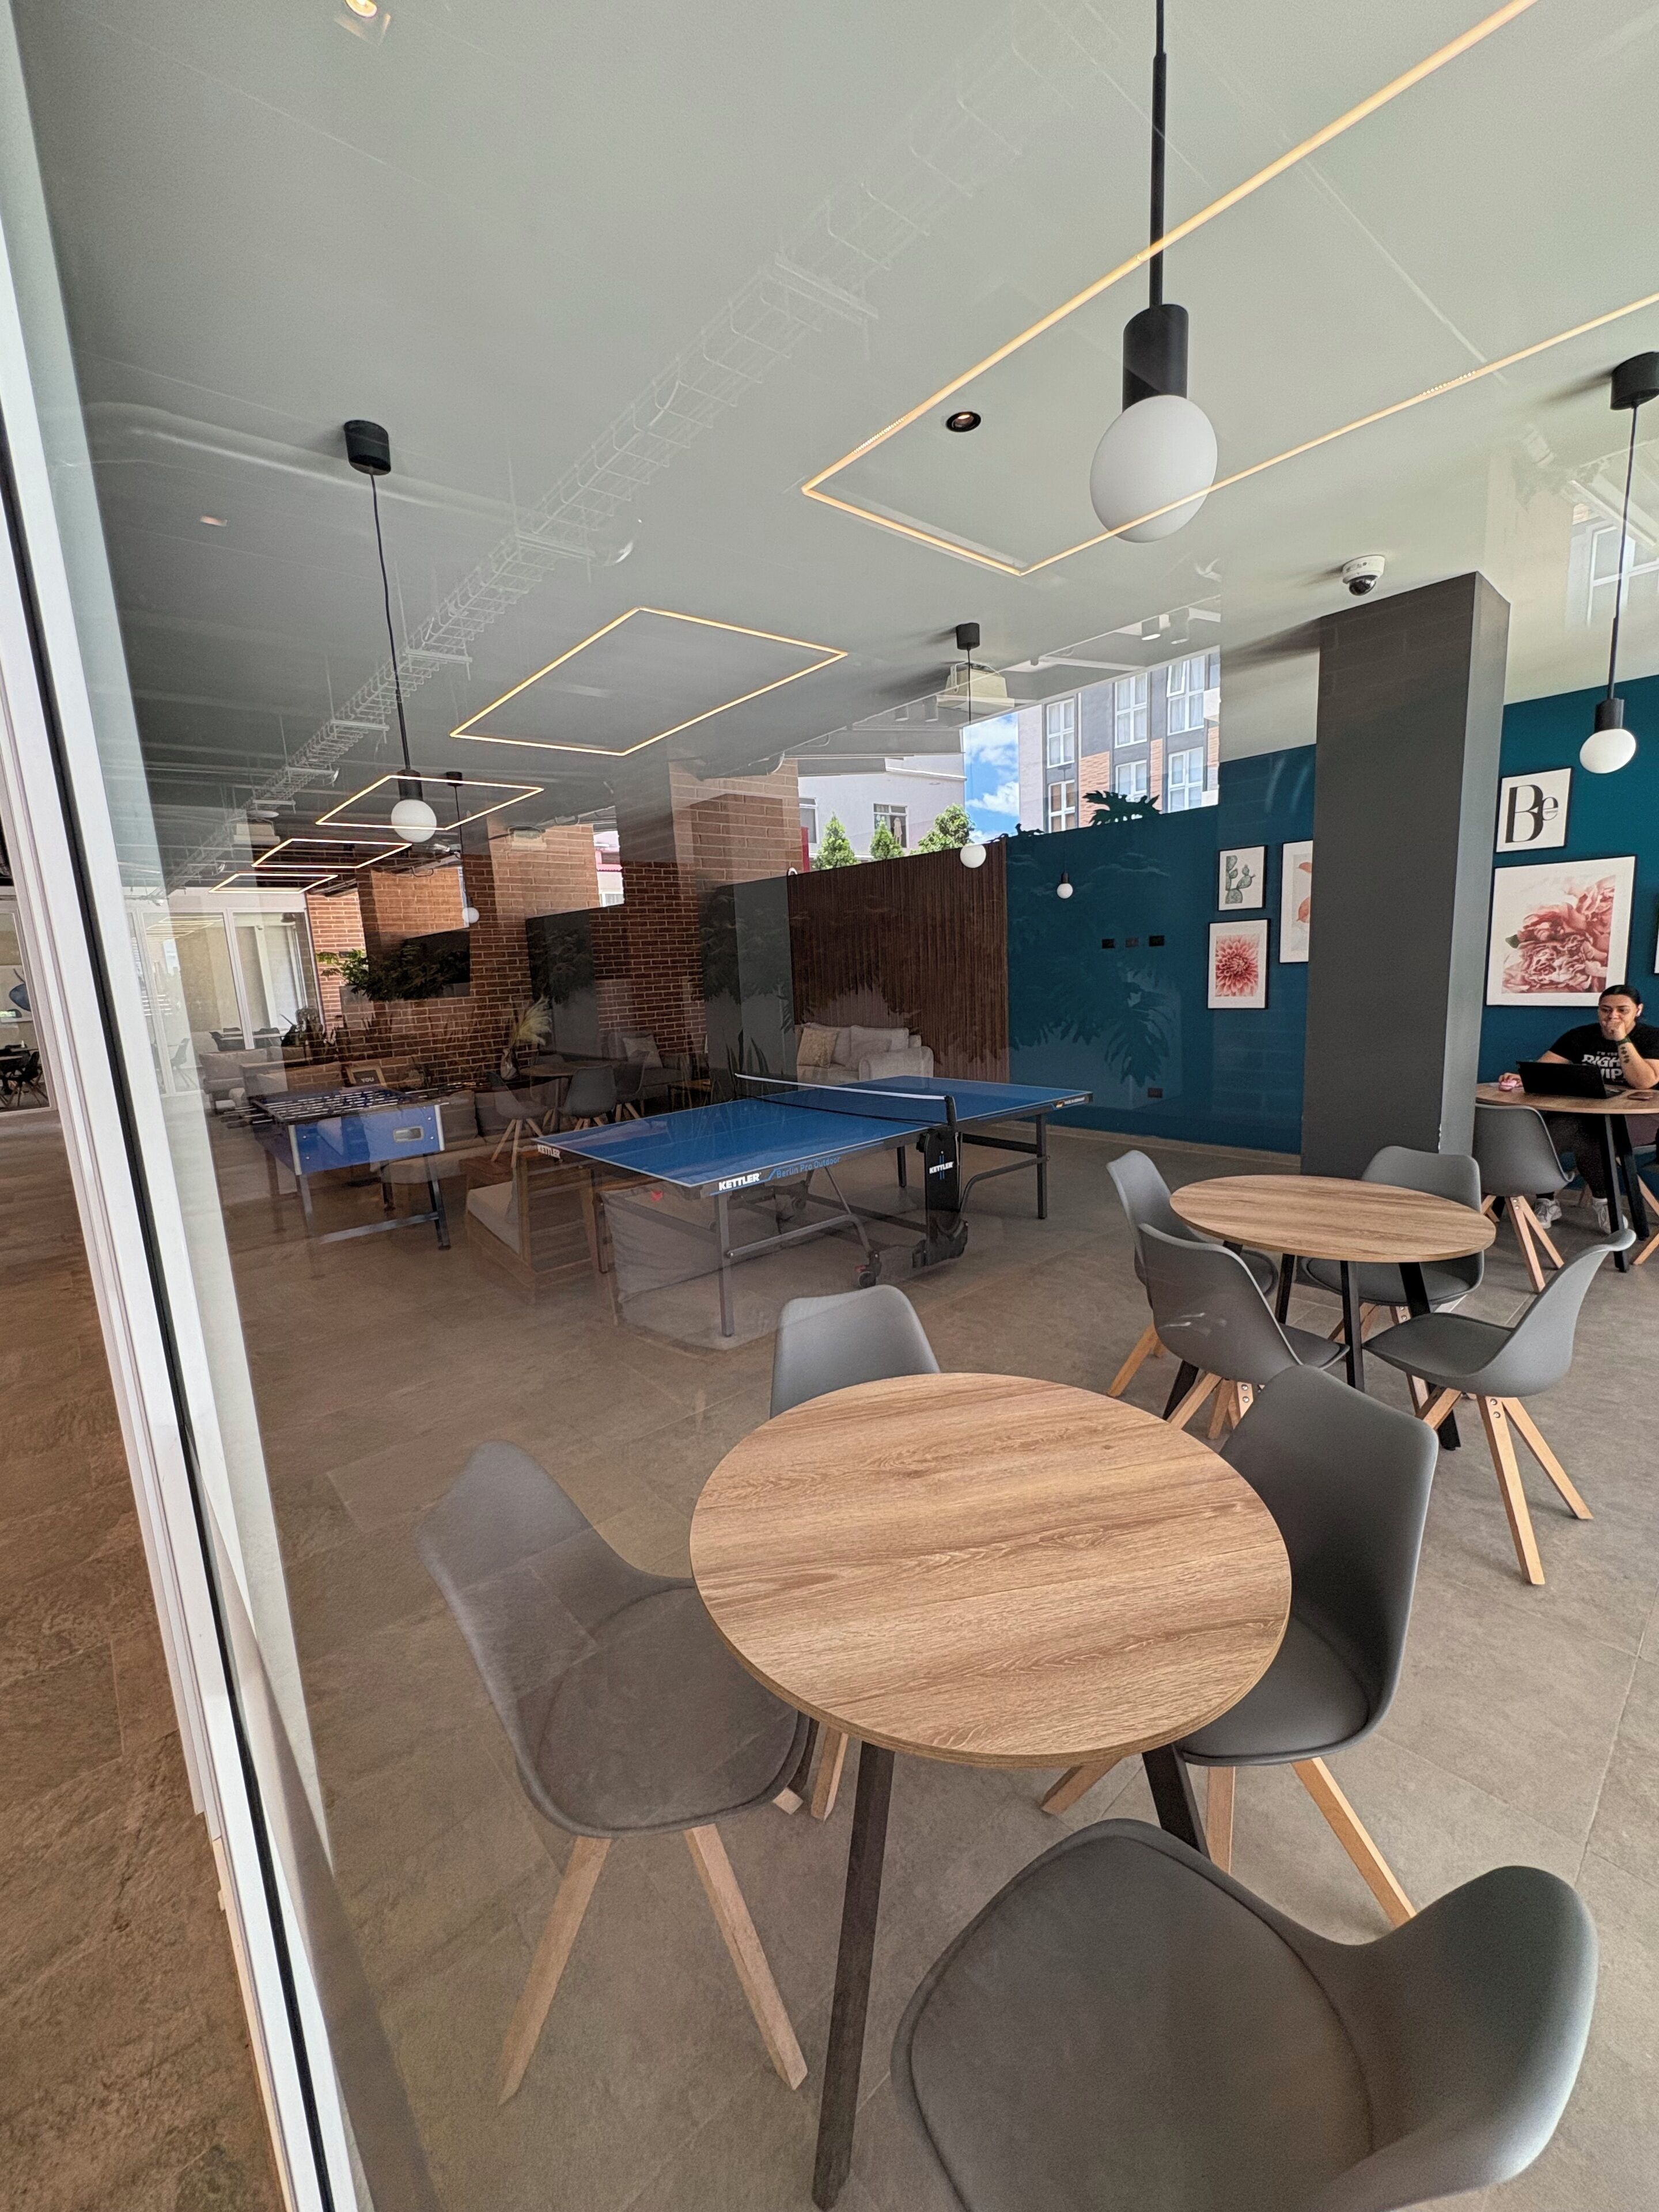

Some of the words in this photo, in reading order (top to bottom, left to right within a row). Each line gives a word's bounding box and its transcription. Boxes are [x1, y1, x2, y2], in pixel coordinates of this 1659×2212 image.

[1504, 785, 1559, 844] Be
[1581, 1054, 1620, 1067] RIGH
[718, 1173, 761, 1191] KETTLER
[776, 1167, 799, 1179] Berlin
[800, 1164, 812, 1172] Pro
[814, 1156, 841, 1168] Outdoor
[929, 1161, 953, 1174] KETTLER
